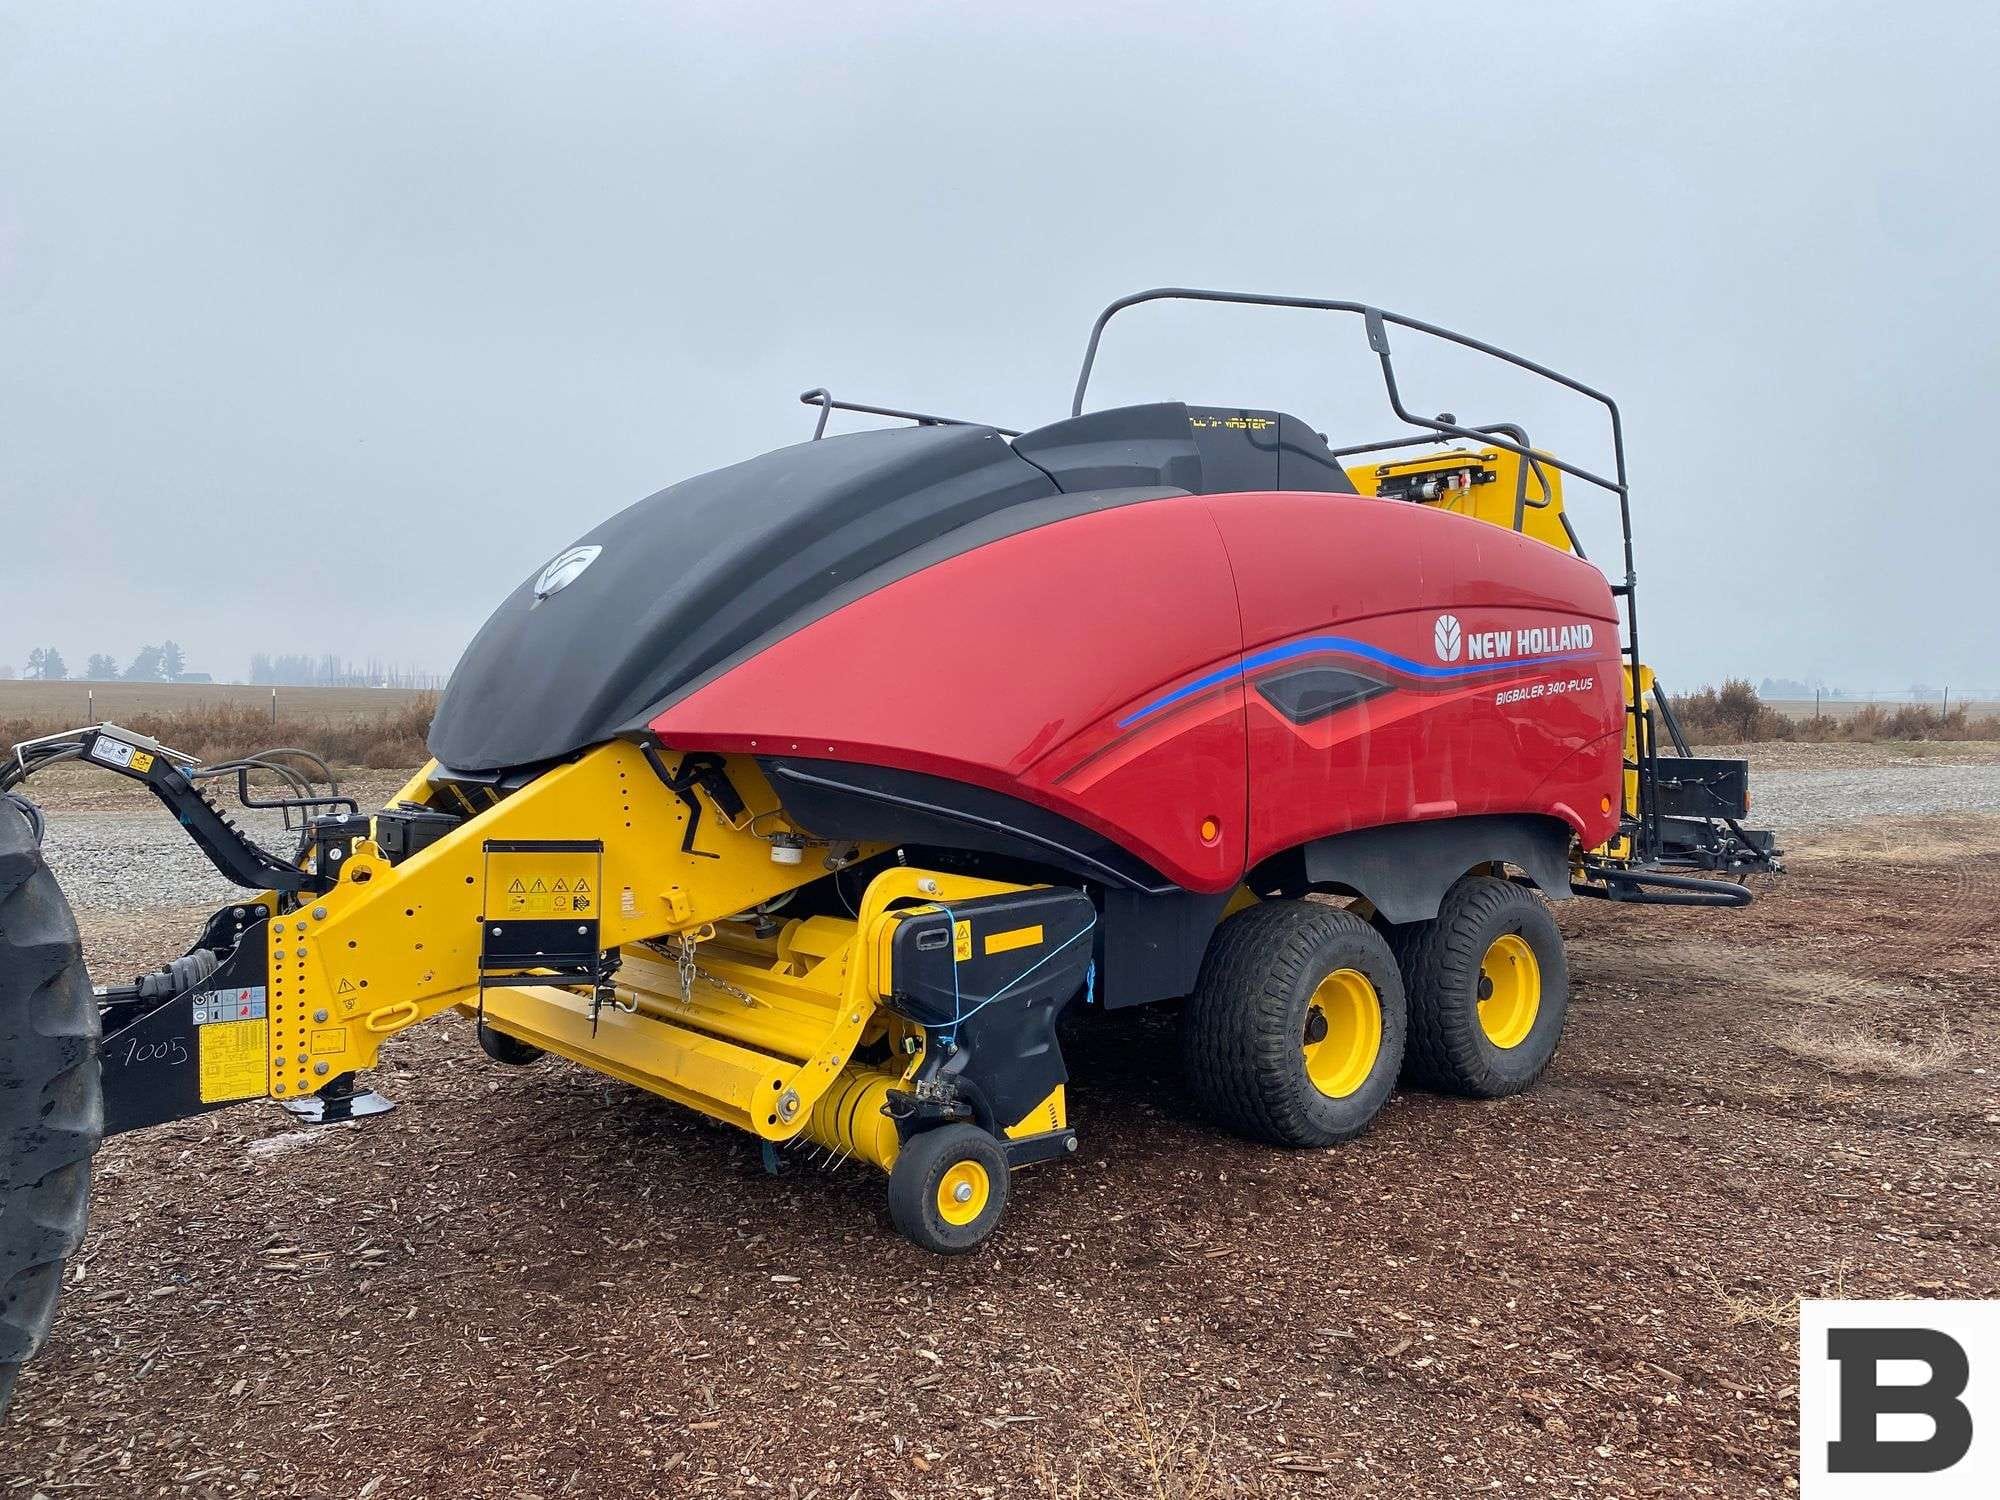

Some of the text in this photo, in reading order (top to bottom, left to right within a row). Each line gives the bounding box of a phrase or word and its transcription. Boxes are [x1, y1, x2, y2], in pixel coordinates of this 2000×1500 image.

[1468, 624, 1594, 661] NEW HOLLAND
[1496, 685, 1544, 706] BIGBALER
[1546, 681, 1566, 695] 340
[125, 1036, 188, 1066] 1005
